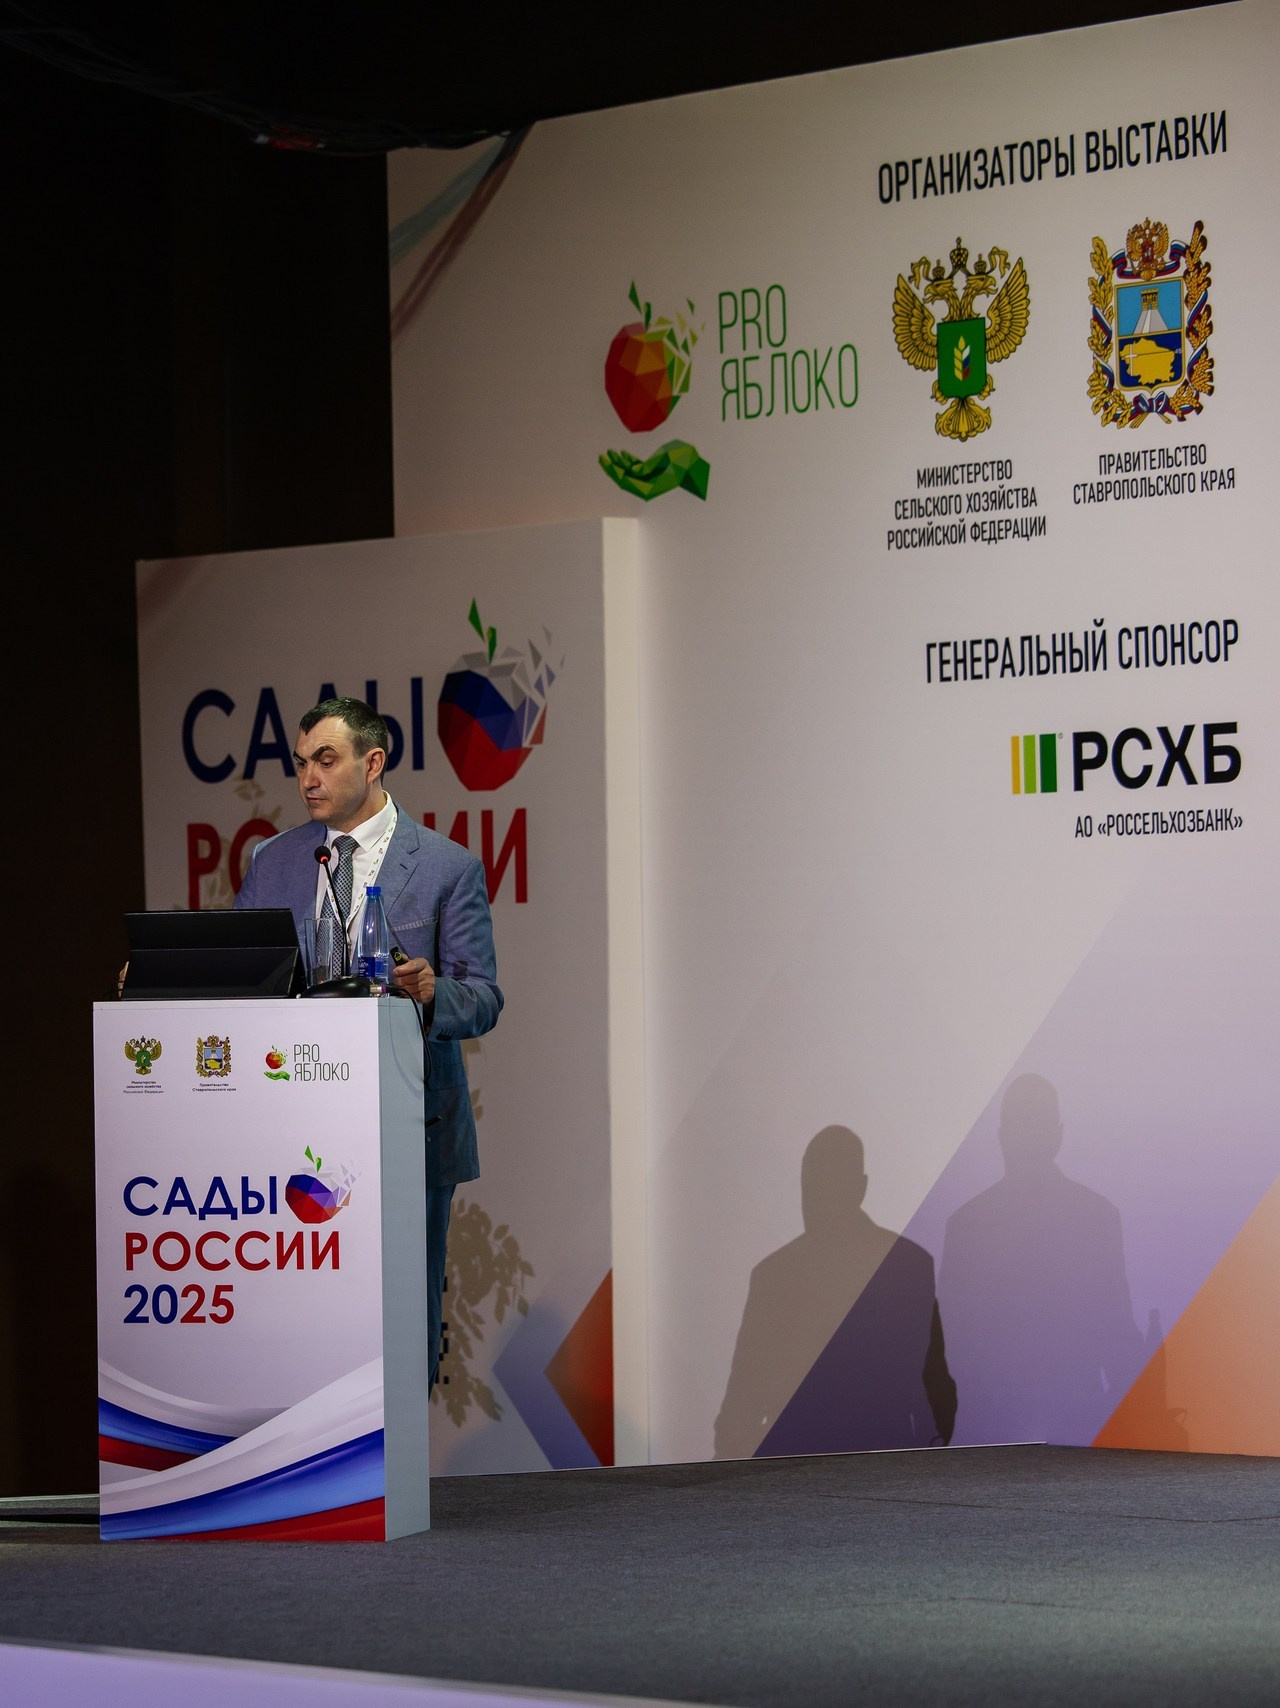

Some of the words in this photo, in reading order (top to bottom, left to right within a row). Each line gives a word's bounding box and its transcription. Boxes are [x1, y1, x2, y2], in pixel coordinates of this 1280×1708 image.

[878, 134, 1075, 204] ОРГАНИЗАТОРЫ
[1085, 110, 1227, 179] ВЫСТАВКИ
[718, 284, 787, 354] PRO
[721, 344, 858, 422] ЯБЛОКО
[917, 459, 1013, 489] МИНИСТЕРСТВО
[1099, 443, 1207, 476] ПРАВИТЕЛЬСТВО
[895, 494, 962, 521] СЕЛЬСКОГО
[966, 485, 1038, 514] ХОЗЯЙСТВА
[1073, 472, 1196, 505] СТАВРОПОЛЬСКОГО
[1200, 468, 1235, 492] КРАЯ
[887, 519, 966, 551] РОССИЙСКОЙ
[970, 516, 1047, 545] ФЕДЕРАЦИИ
[926, 618, 1108, 684] ГЕНЕРАЛЬНЫЙ
[1118, 619, 1239, 670] СПОНСОР
[182, 677, 424, 784] САЫ
[1072, 721, 1242, 792] РСХБ
[1075, 815, 1094, 839] АО
[1097, 807, 1244, 837] «РОССЕЛЬХОЗБАНК»
[293, 1044, 320, 1062] PRO
[294, 1062, 350, 1082] ЯБЛОКО
[123, 1176, 278, 1221] САДЫ
[125, 1231, 340, 1272] РОССИИ
[123, 1284, 235, 1324] 2025
